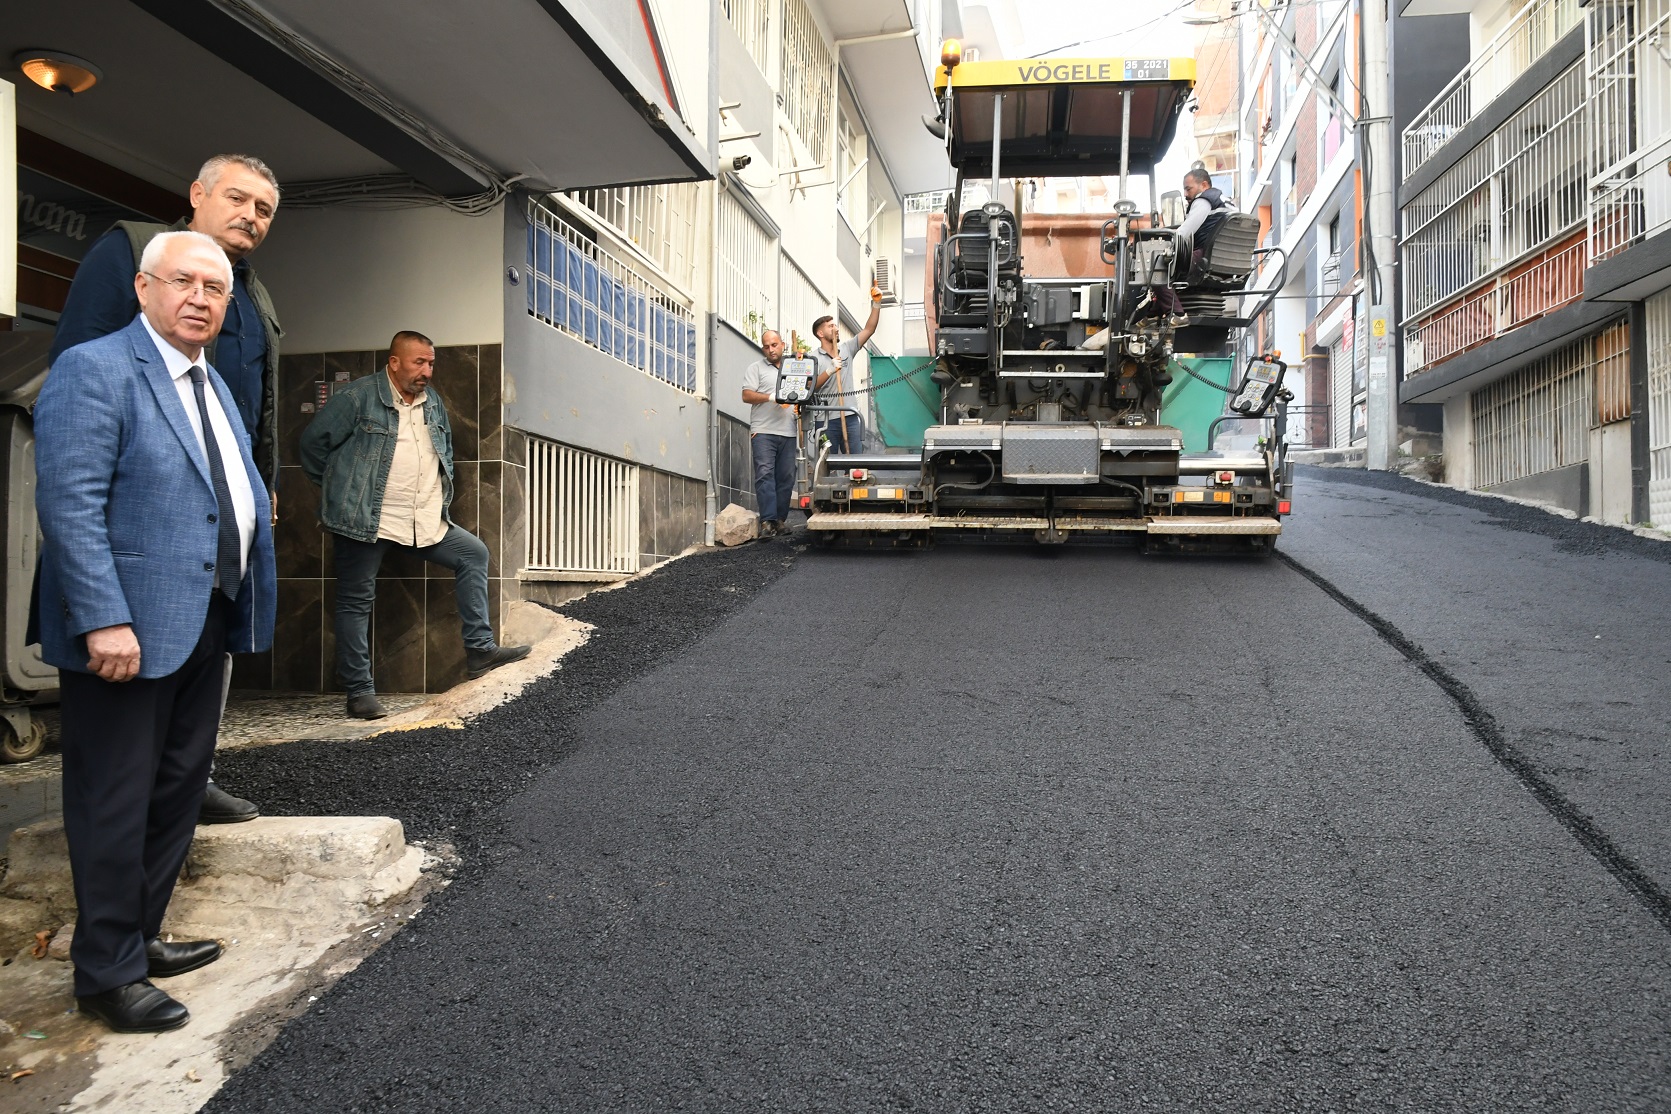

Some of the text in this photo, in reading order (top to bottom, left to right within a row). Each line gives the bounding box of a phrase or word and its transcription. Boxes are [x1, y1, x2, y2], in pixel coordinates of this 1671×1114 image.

[1126, 60, 1167, 69] 35 2021
[1018, 61, 1111, 82] VÖGELE
[1137, 69, 1149, 78] 01
